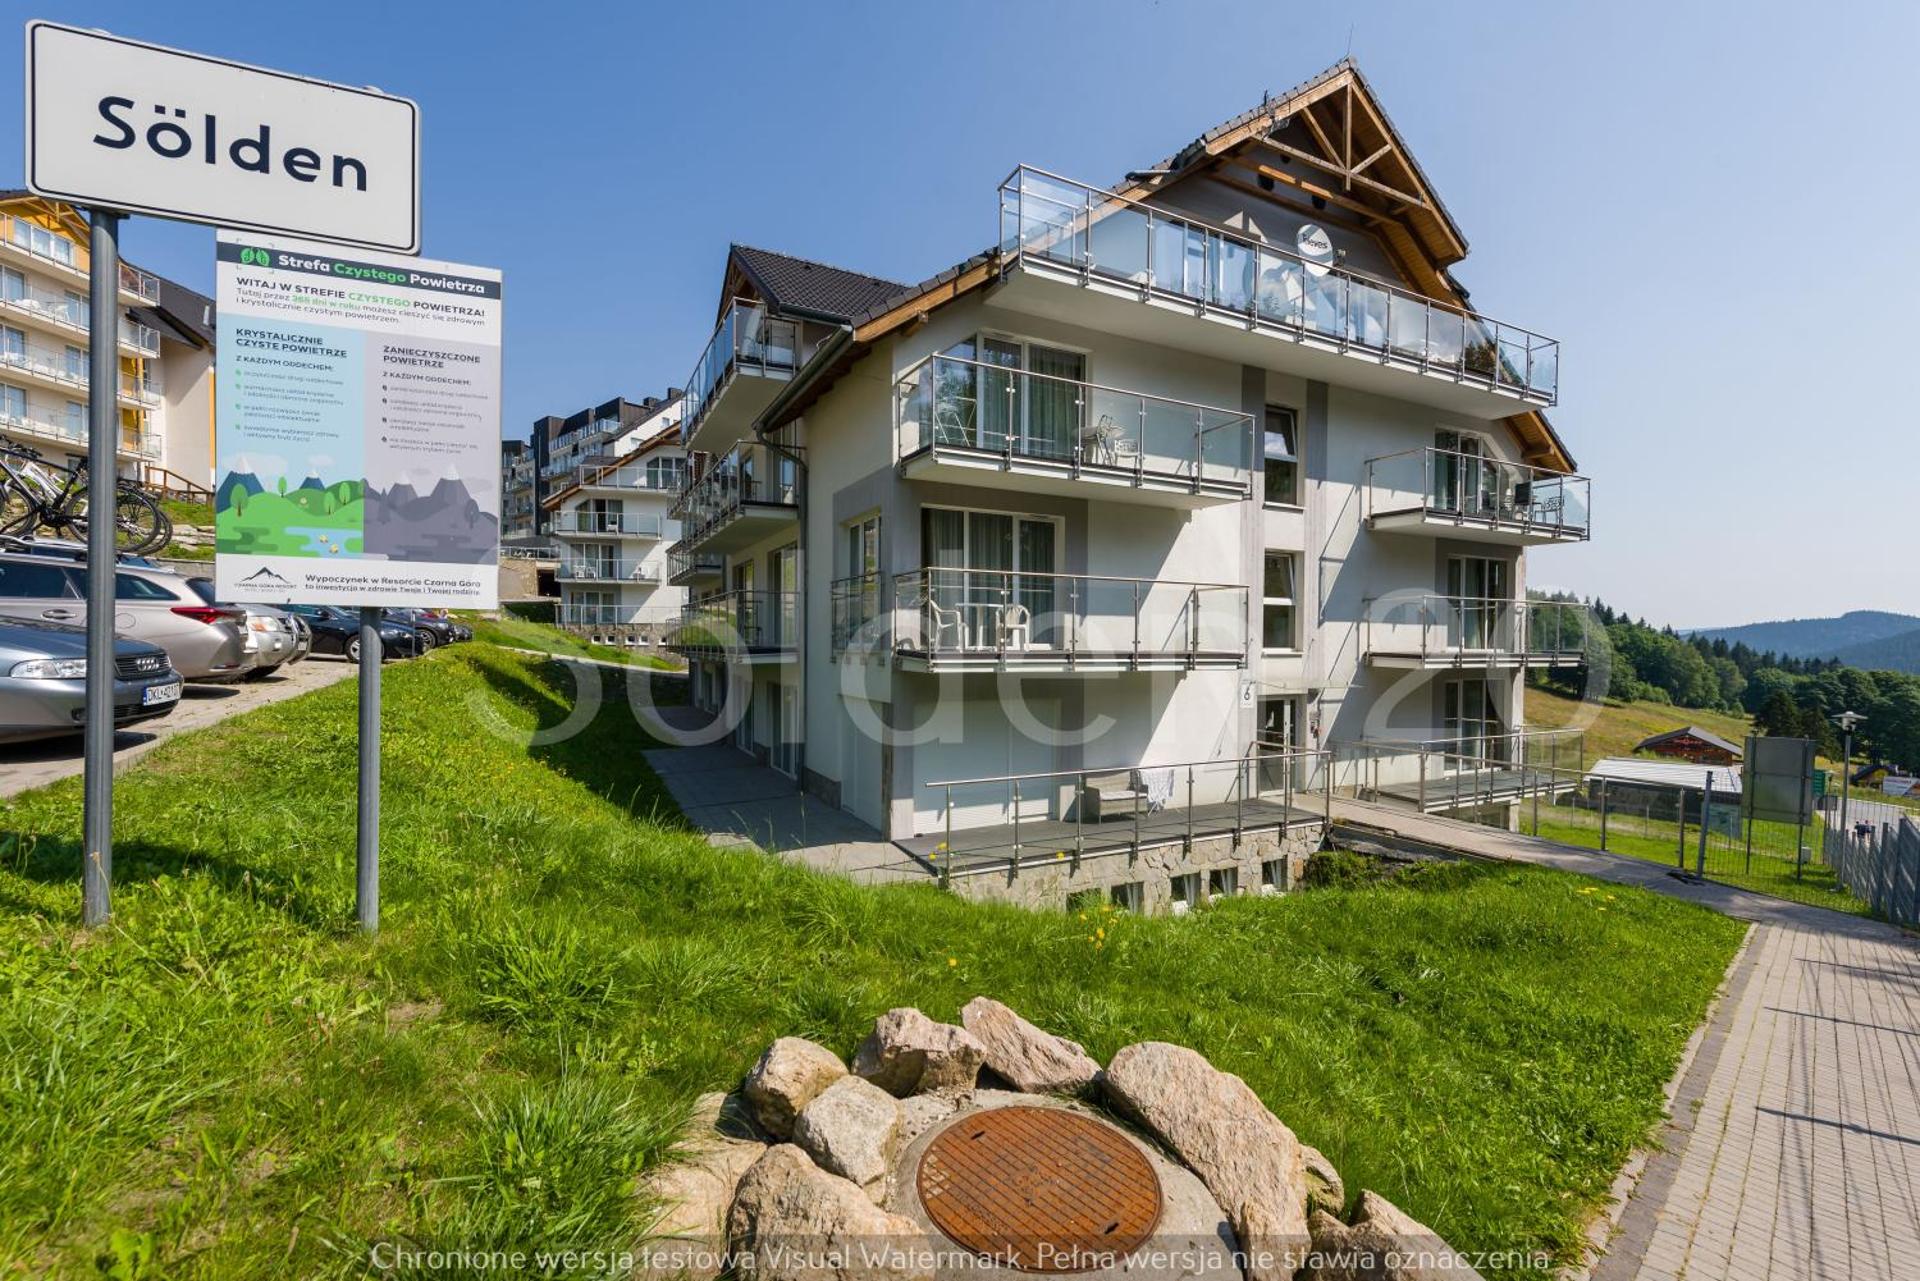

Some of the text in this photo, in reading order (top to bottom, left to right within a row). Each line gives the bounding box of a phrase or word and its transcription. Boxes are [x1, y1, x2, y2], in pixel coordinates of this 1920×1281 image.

[93, 96, 367, 192] Sölden
[278, 255, 485, 294] Strefa Czystego Powietrza
[236, 277, 485, 317] WITAJ W STREFIE CZYSTEGO POWIETRZA!
[236, 288, 262, 298] Tutaj
[264, 292, 290, 302] przez
[339, 301, 361, 310] roku
[362, 305, 396, 315] możesz
[446, 315, 485, 326] zdrowym
[241, 298, 302, 311] krystalicznie
[304, 305, 342, 317] czystym
[236, 328, 323, 345] KRYSTALICZNIE
[236, 338, 347, 358] CZYSTE POWIETRZE
[383, 345, 481, 363] ZANIECZYSZCZONE
[243, 355, 281, 366] KAŻDYM
[383, 355, 444, 369] POWIETRZE
[305, 574, 369, 584] Wypoczynek
[381, 577, 422, 585] Resorcie
[424, 579, 457, 587] Czarna
[1243, 686, 1250, 701] 6
